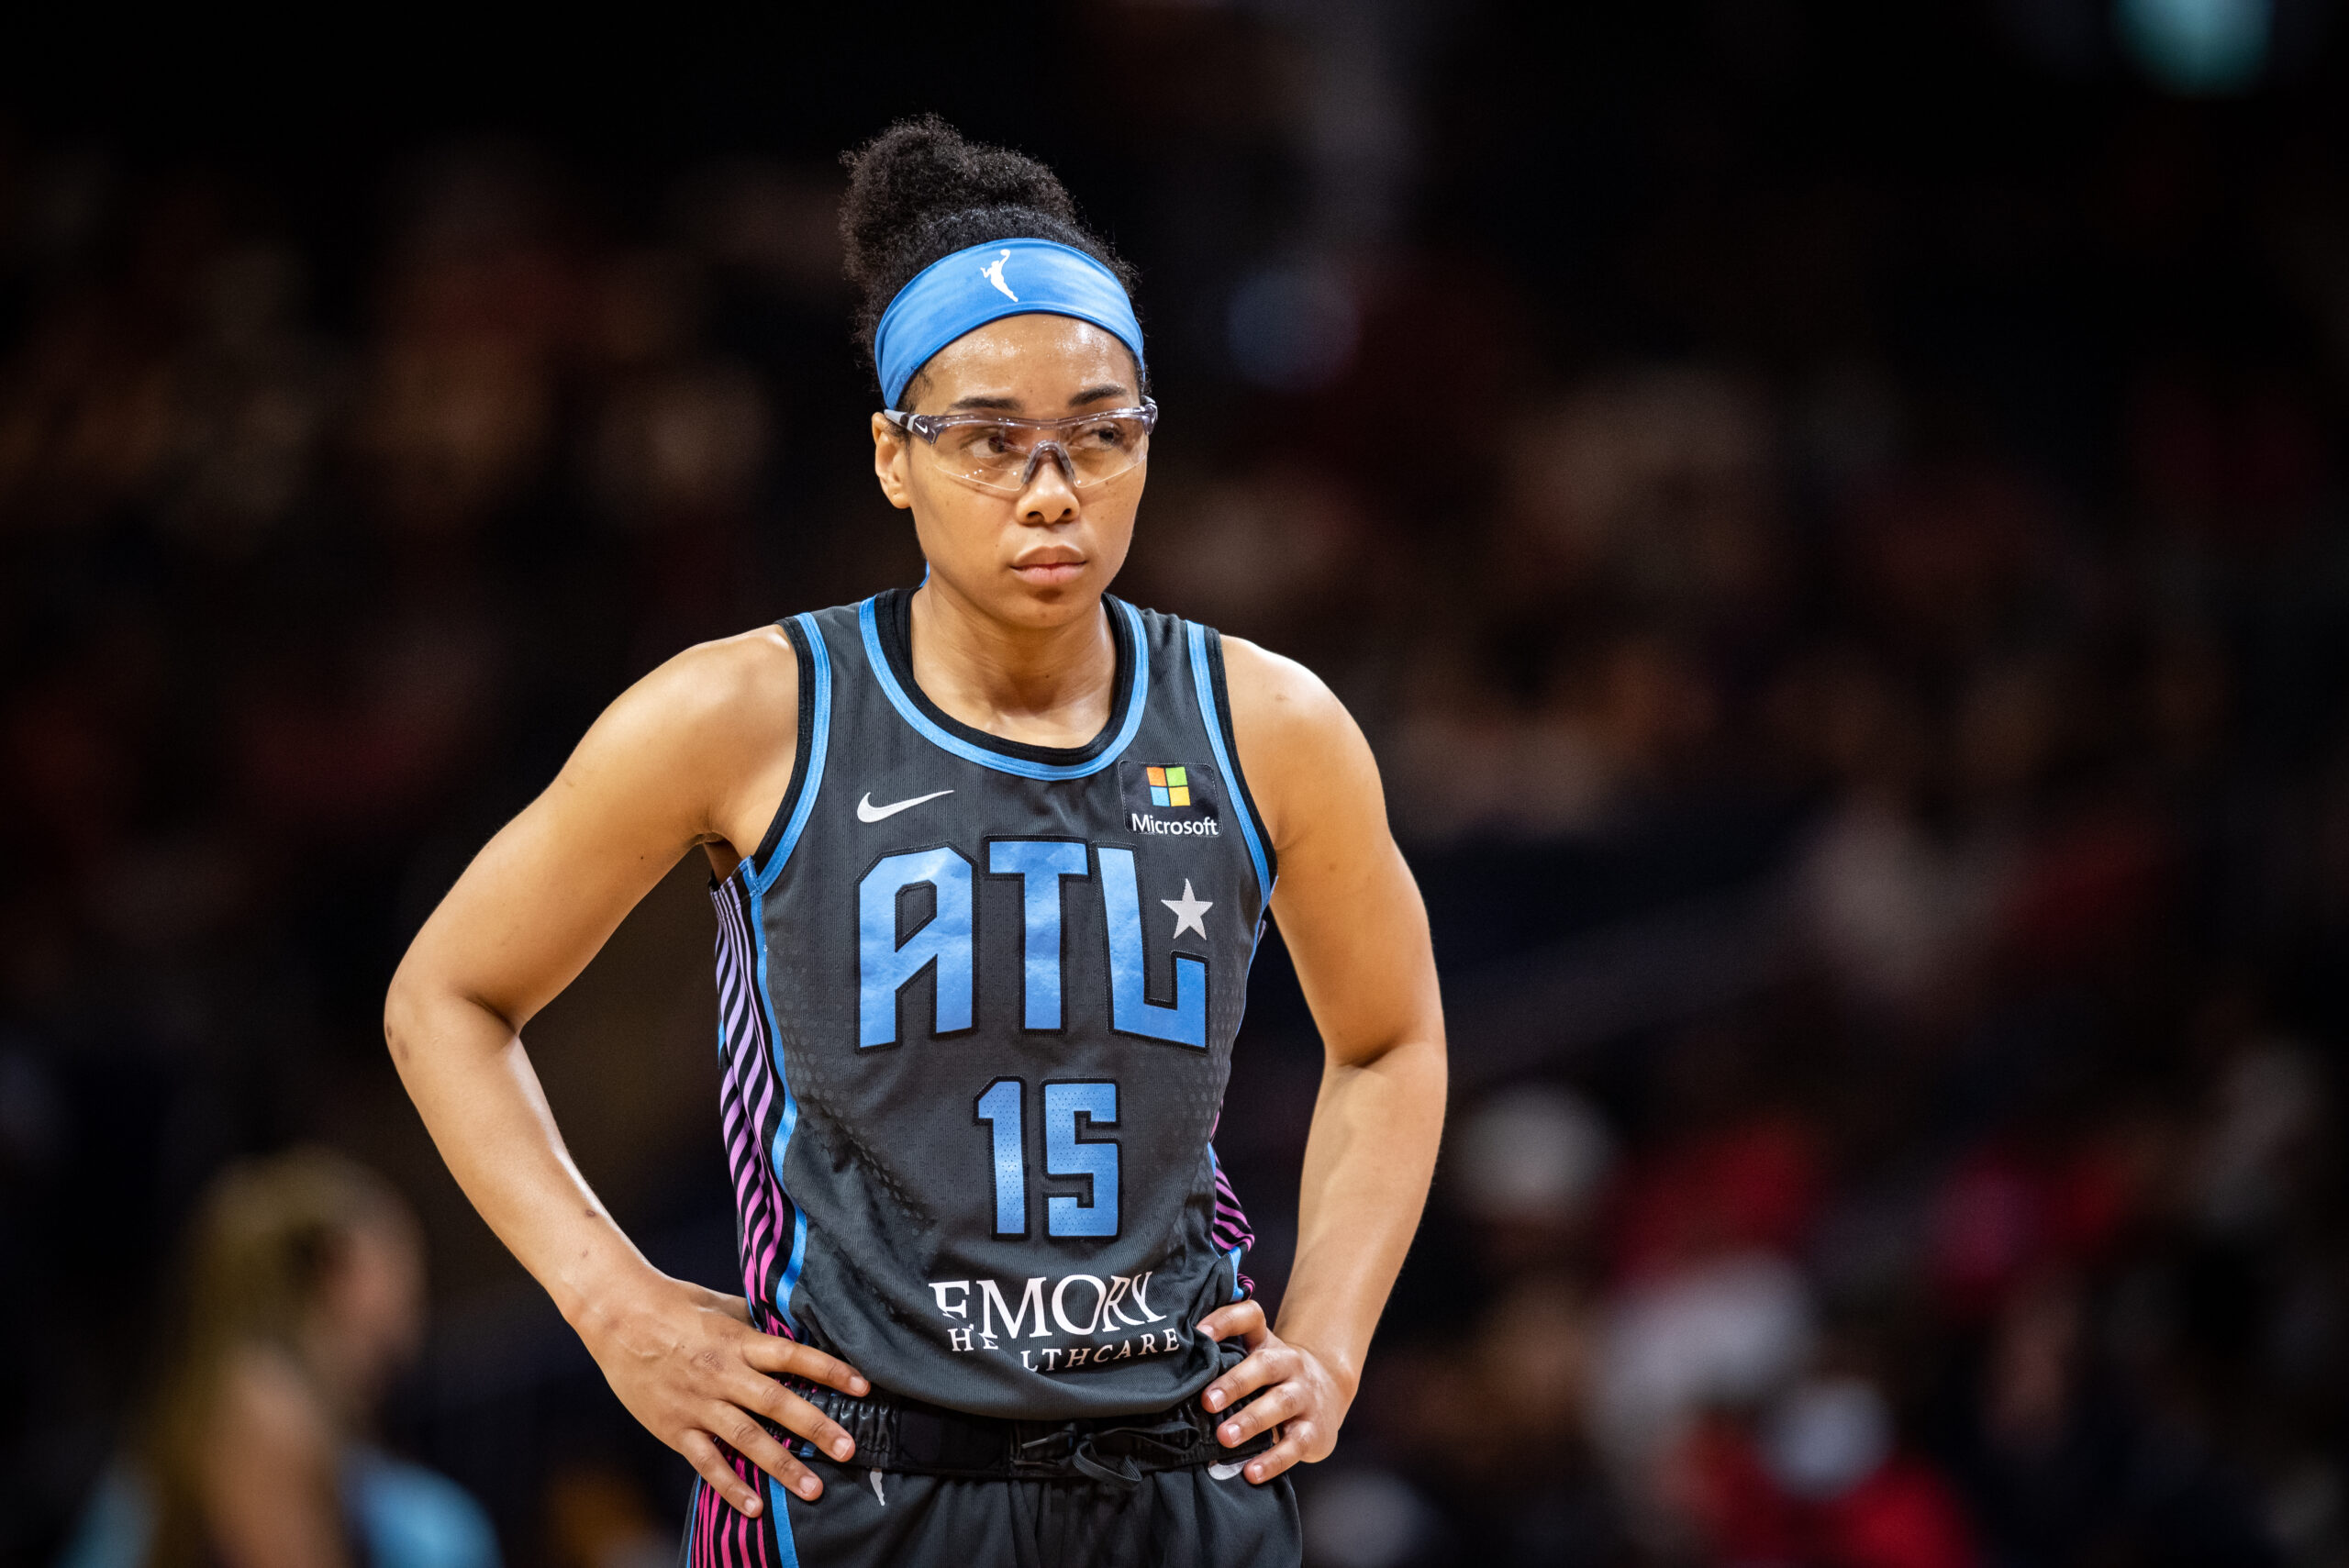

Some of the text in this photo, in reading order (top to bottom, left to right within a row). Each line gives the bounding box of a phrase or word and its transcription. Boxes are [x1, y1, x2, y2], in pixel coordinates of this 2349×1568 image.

[1131, 813, 1219, 836] Microsoft
[857, 836, 1208, 1051] ATL
[974, 1077, 1122, 1238] 15
[928, 1271, 1167, 1340] EMORY
[947, 1327, 1180, 1373] HELTHCARE
